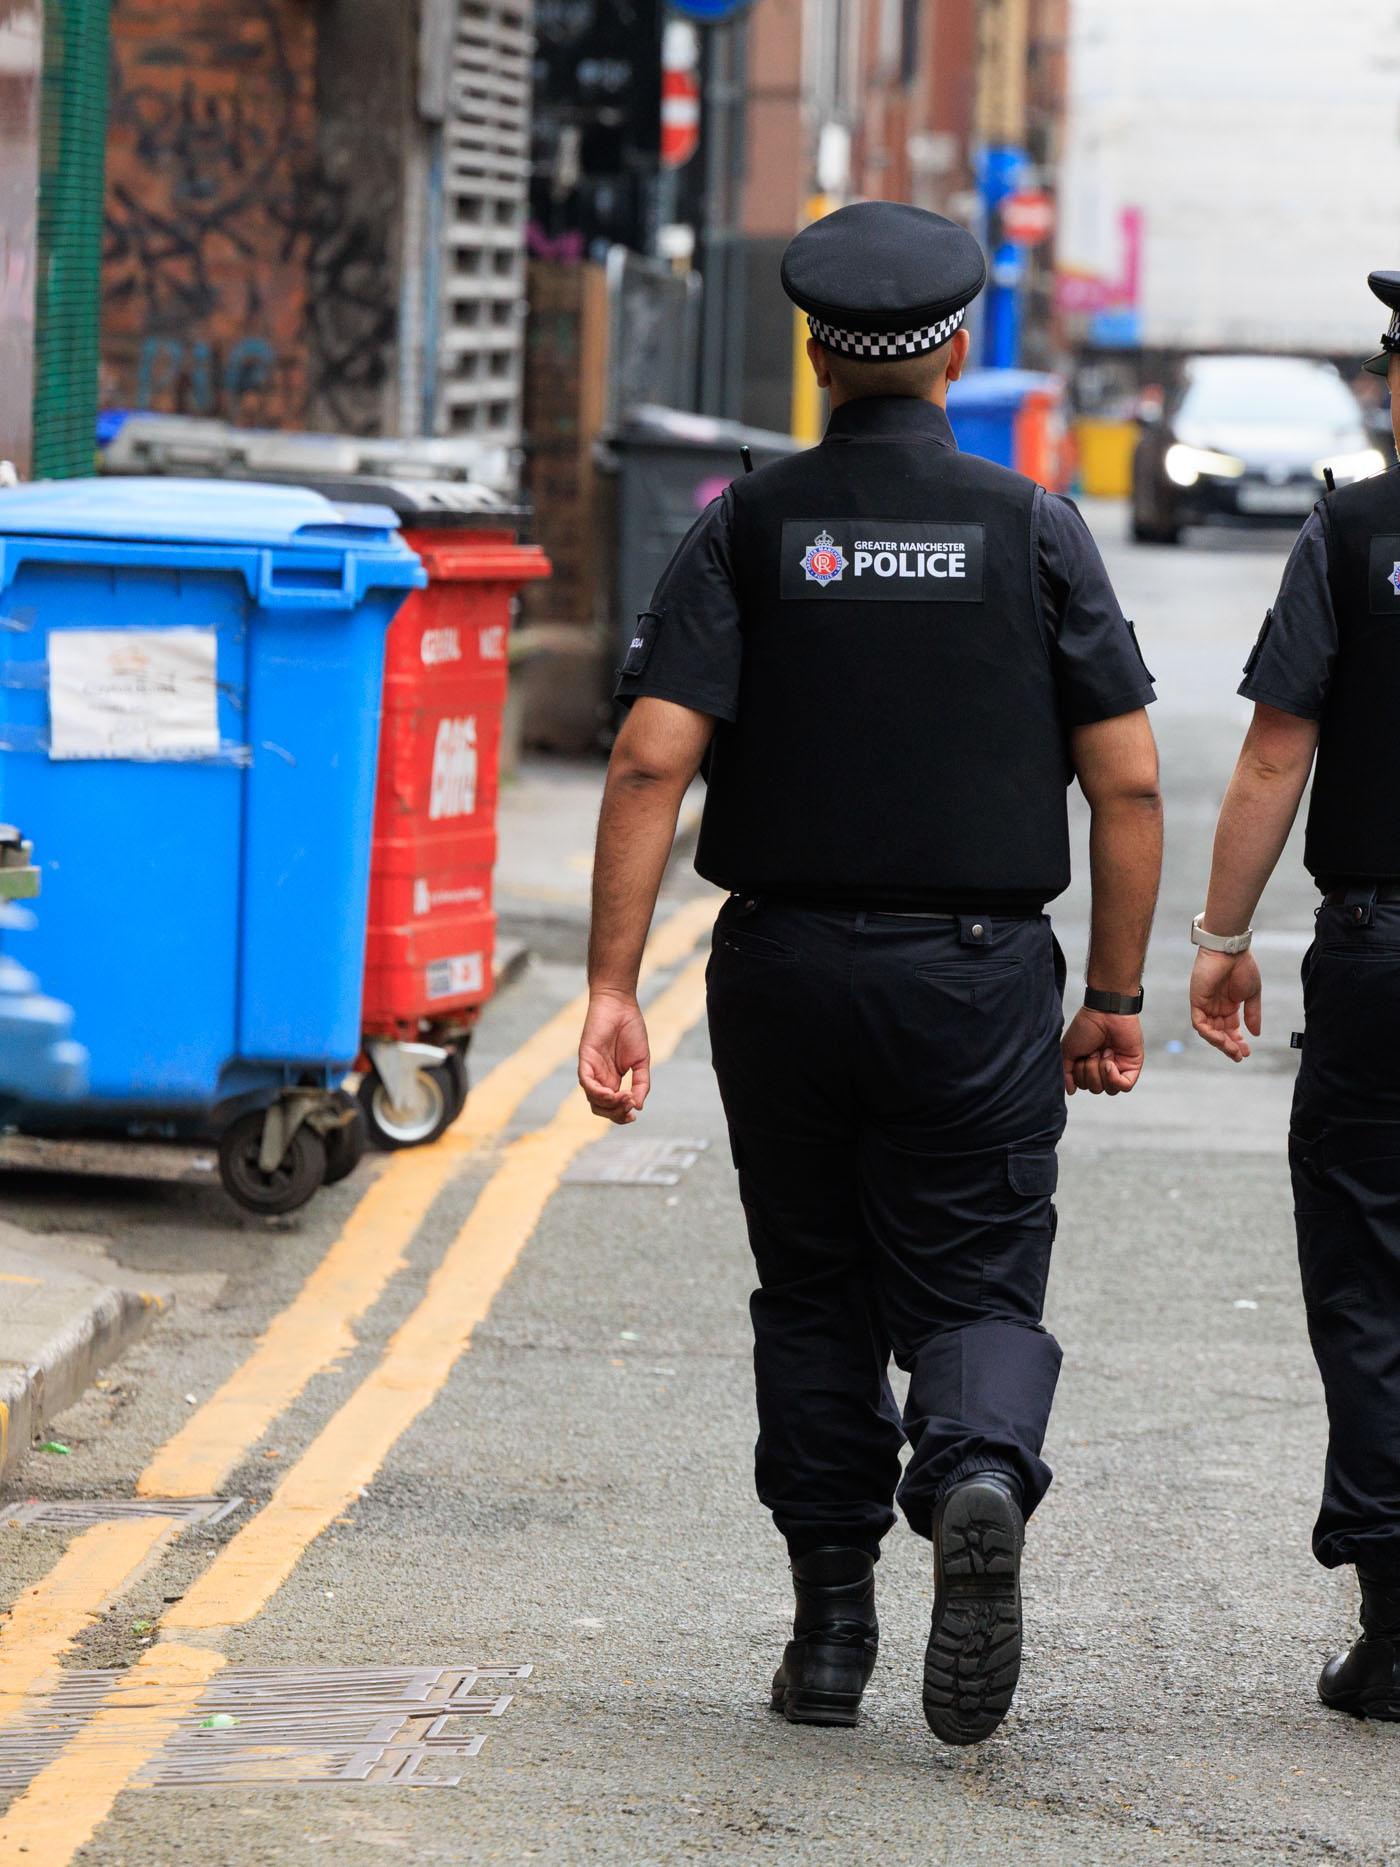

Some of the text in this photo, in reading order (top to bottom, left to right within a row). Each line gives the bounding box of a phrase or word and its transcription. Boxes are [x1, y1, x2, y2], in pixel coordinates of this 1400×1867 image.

[854, 541, 966, 552] GREATER MANCHESTER
[854, 552, 966, 578] POLICE
